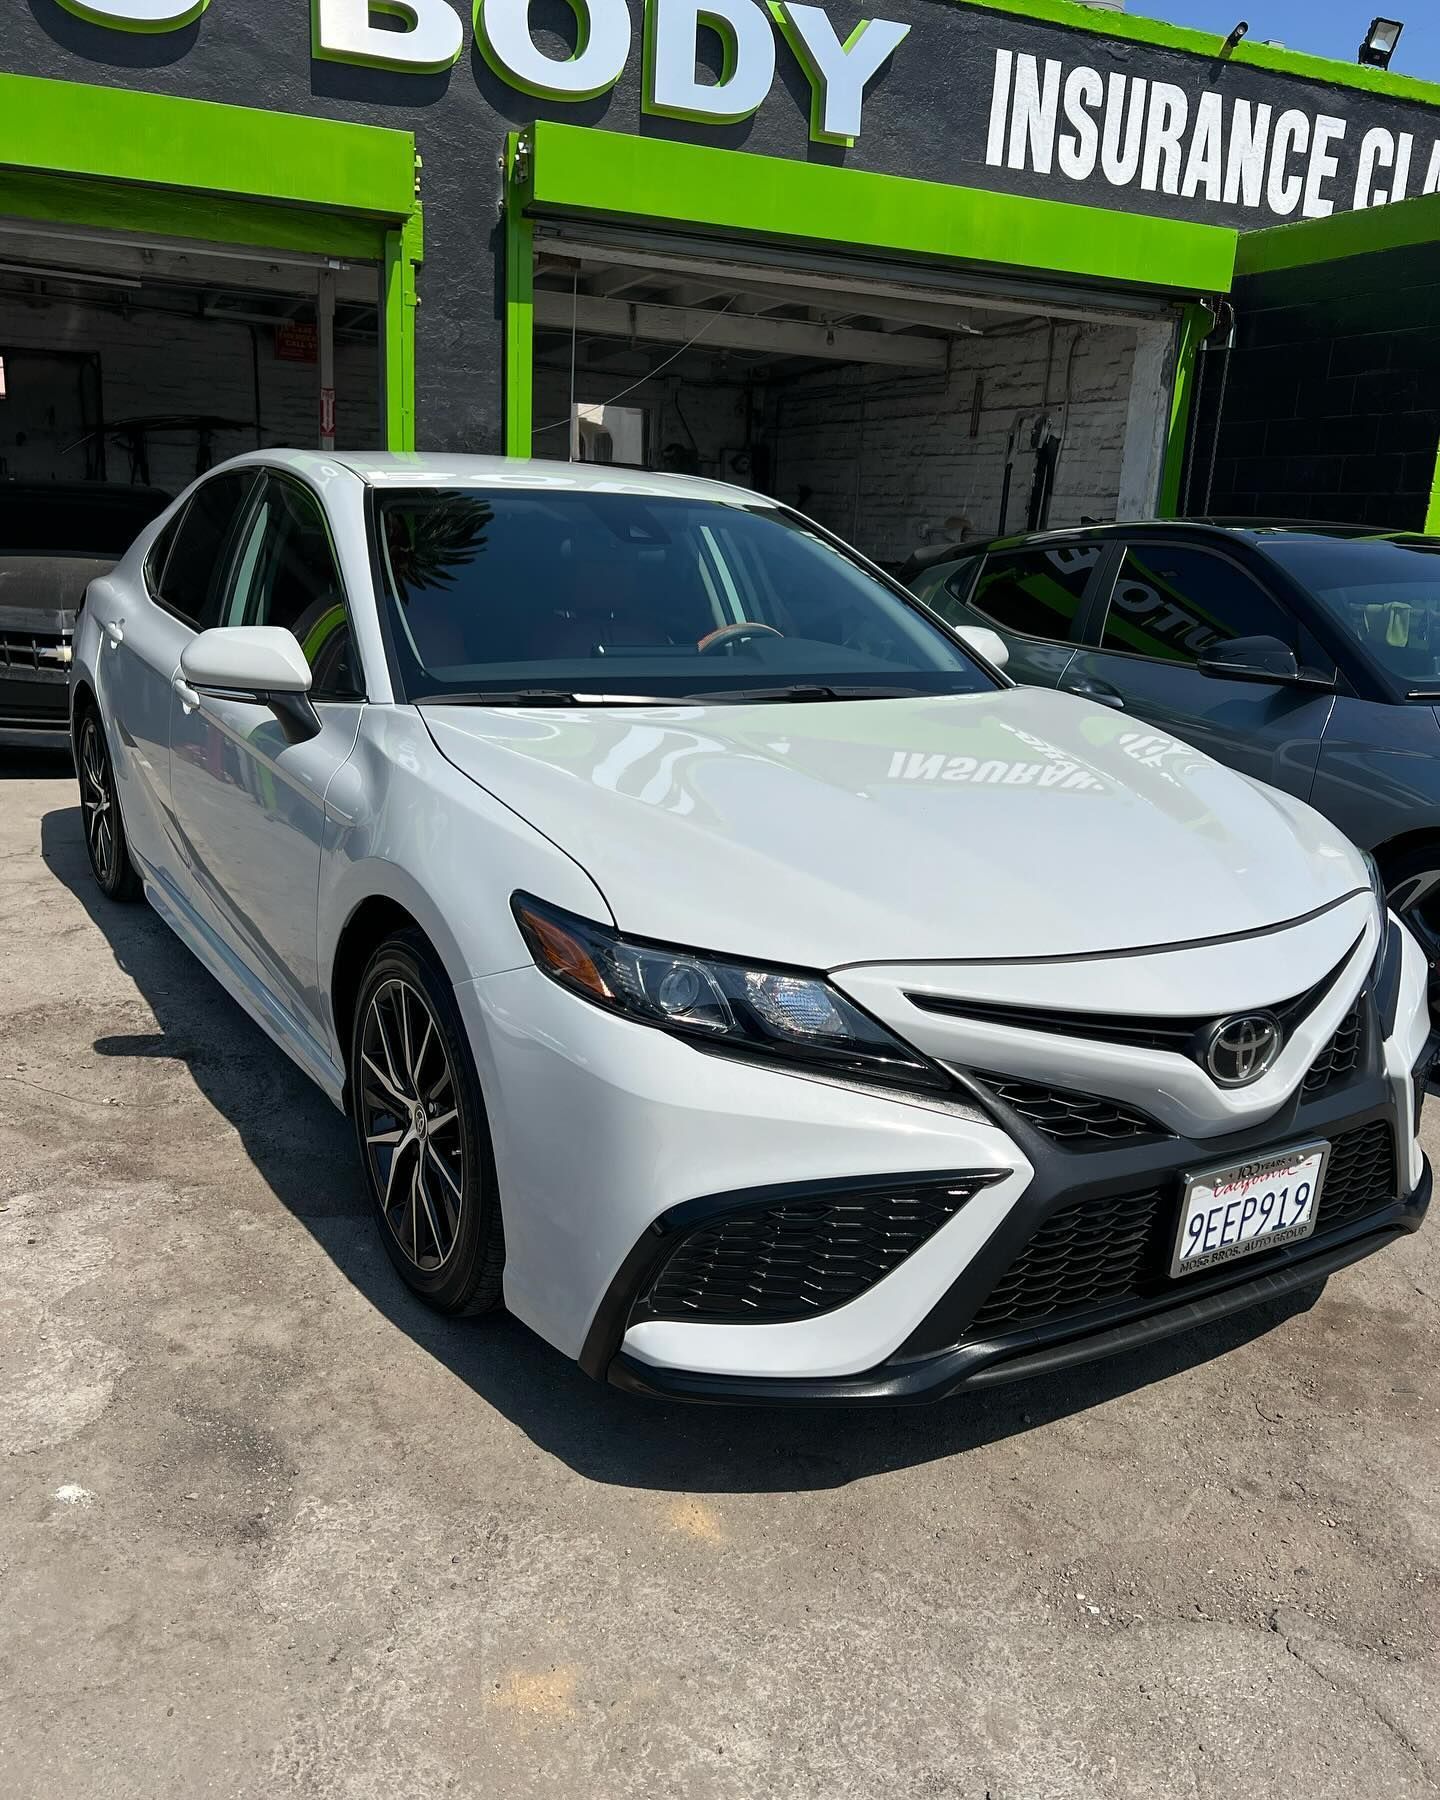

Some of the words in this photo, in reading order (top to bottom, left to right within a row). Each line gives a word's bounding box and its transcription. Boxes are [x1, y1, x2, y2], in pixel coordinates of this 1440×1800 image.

[313, 0, 912, 146] BODY
[985, 48, 1347, 218] INSURANCE
[1353, 127, 1440, 211] CL
[1184, 1182, 1310, 1259] 9EEP919
[1242, 1237, 1272, 1254] AUTO
[1273, 1225, 1308, 1243] GROUP
